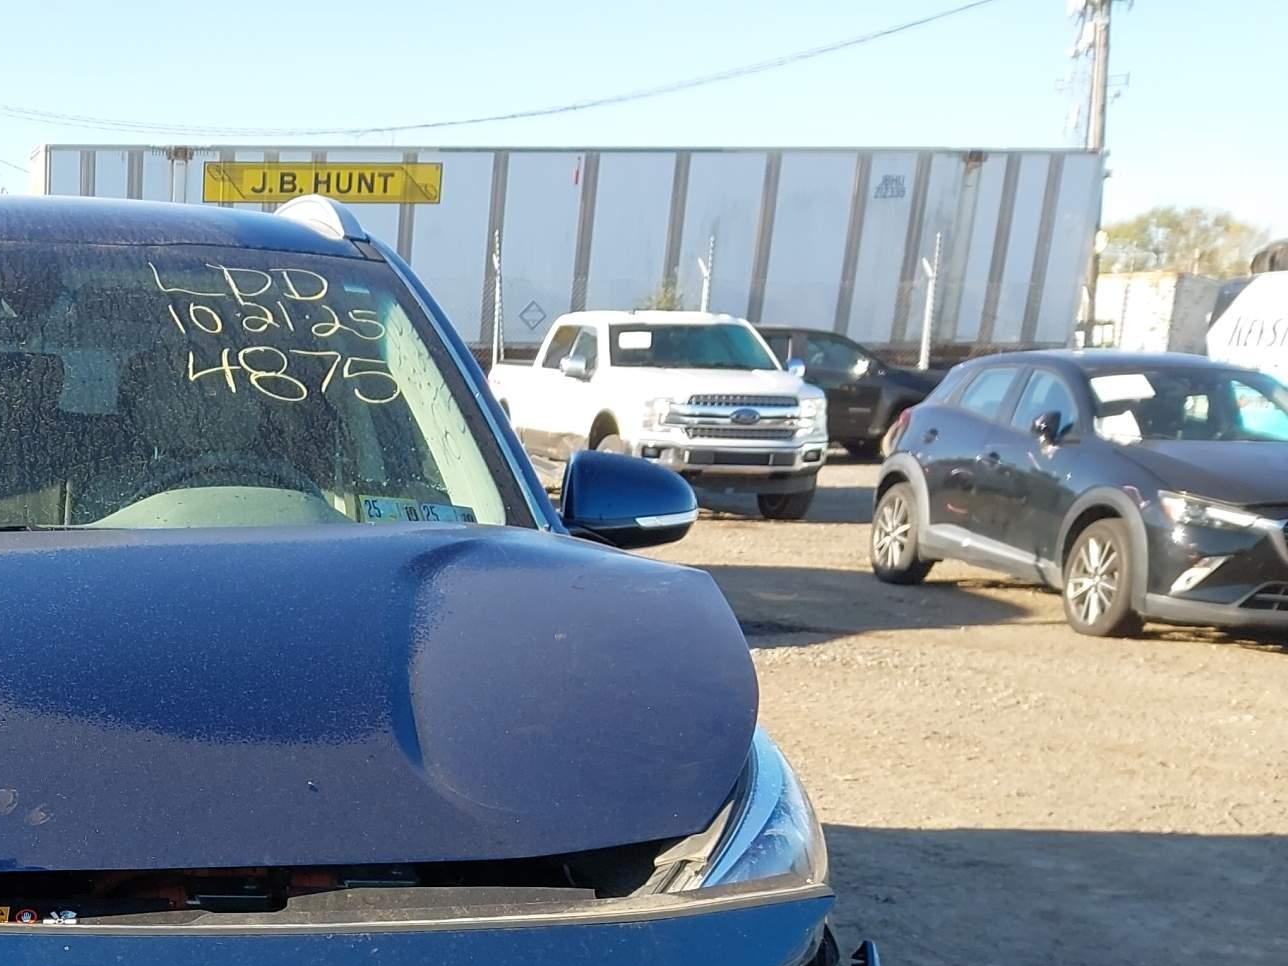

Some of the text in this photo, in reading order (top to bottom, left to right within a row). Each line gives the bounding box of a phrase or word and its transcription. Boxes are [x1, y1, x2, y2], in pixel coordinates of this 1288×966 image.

[251, 171, 395, 194] J.B. HUNT
[188, 346, 400, 403] 4875
[364, 499, 382, 518] 25
[422, 505, 440, 521] 25
